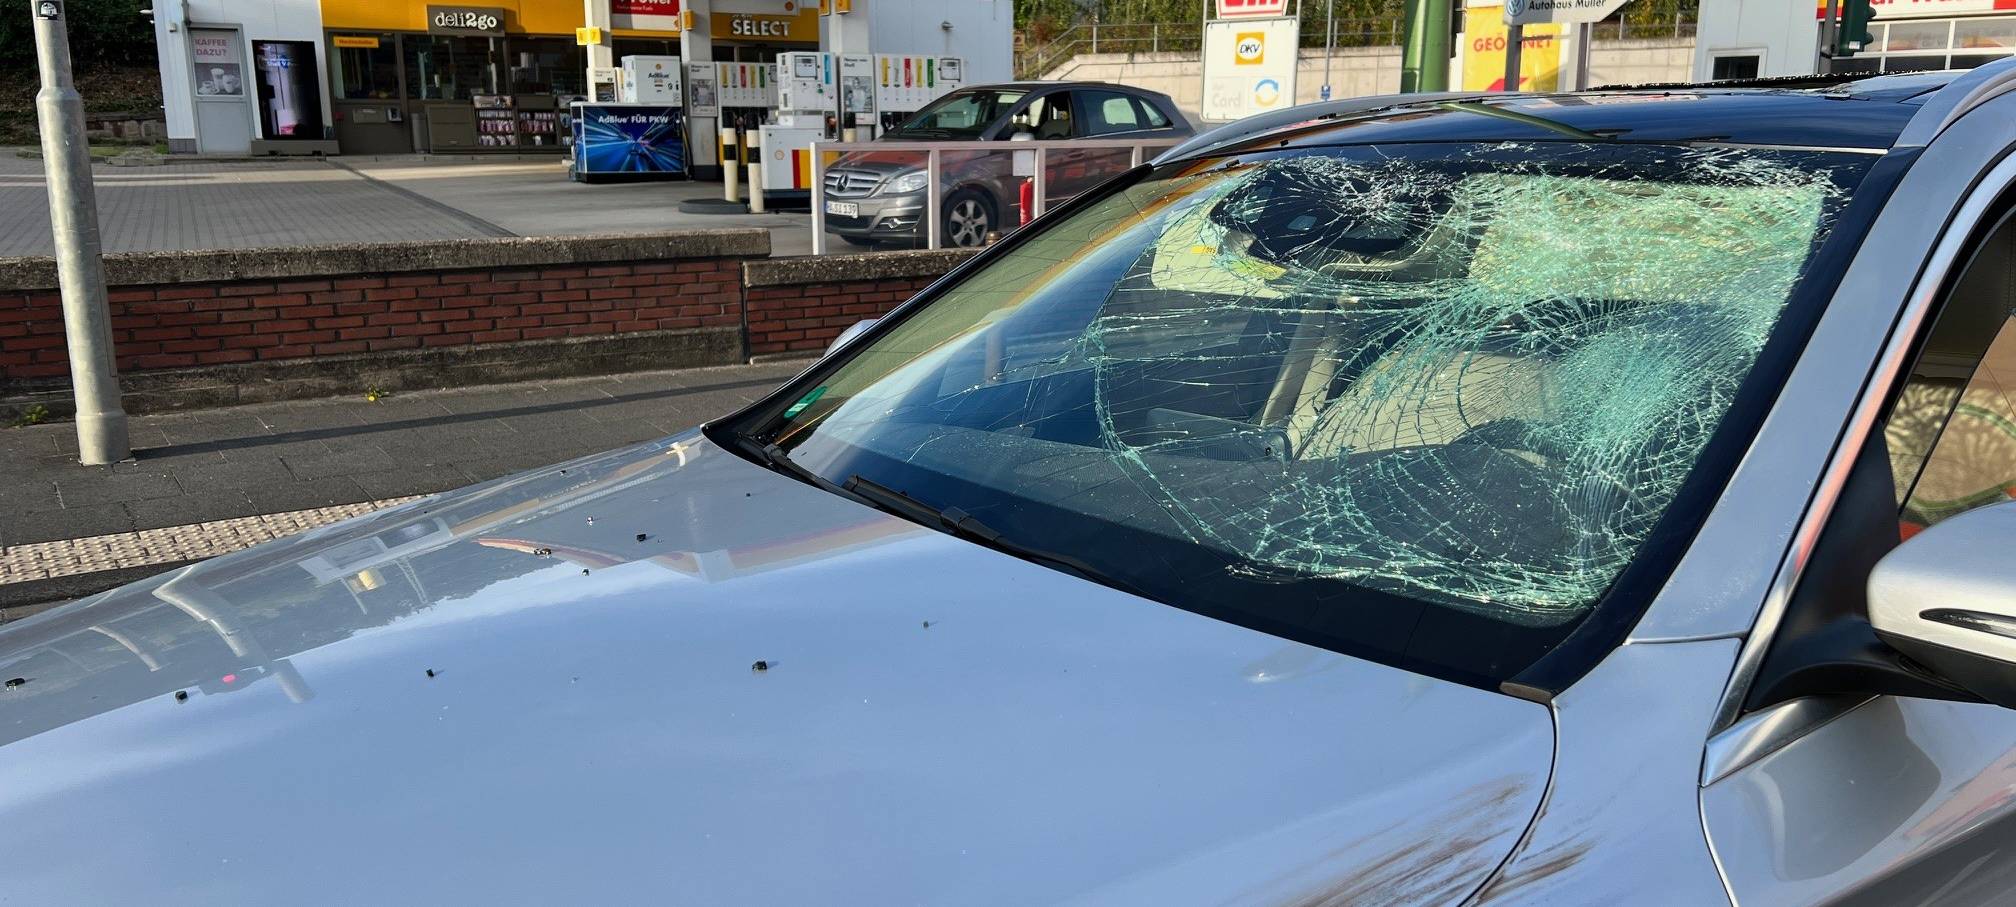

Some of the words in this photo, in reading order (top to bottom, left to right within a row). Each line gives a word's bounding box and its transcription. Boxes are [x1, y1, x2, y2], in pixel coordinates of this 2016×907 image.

[1528, 0, 1572, 10] Autohaus
[434, 11, 498, 30] deli2go
[732, 19, 792, 36] SELECT
[194, 38, 228, 47] KAFFEE
[1473, 32, 1551, 52] GEÖNET
[195, 48, 228, 57] DAZU?
[1240, 44, 1261, 54] DKV
[631, 114, 647, 123] FÜR
[649, 115, 669, 123] PKW
